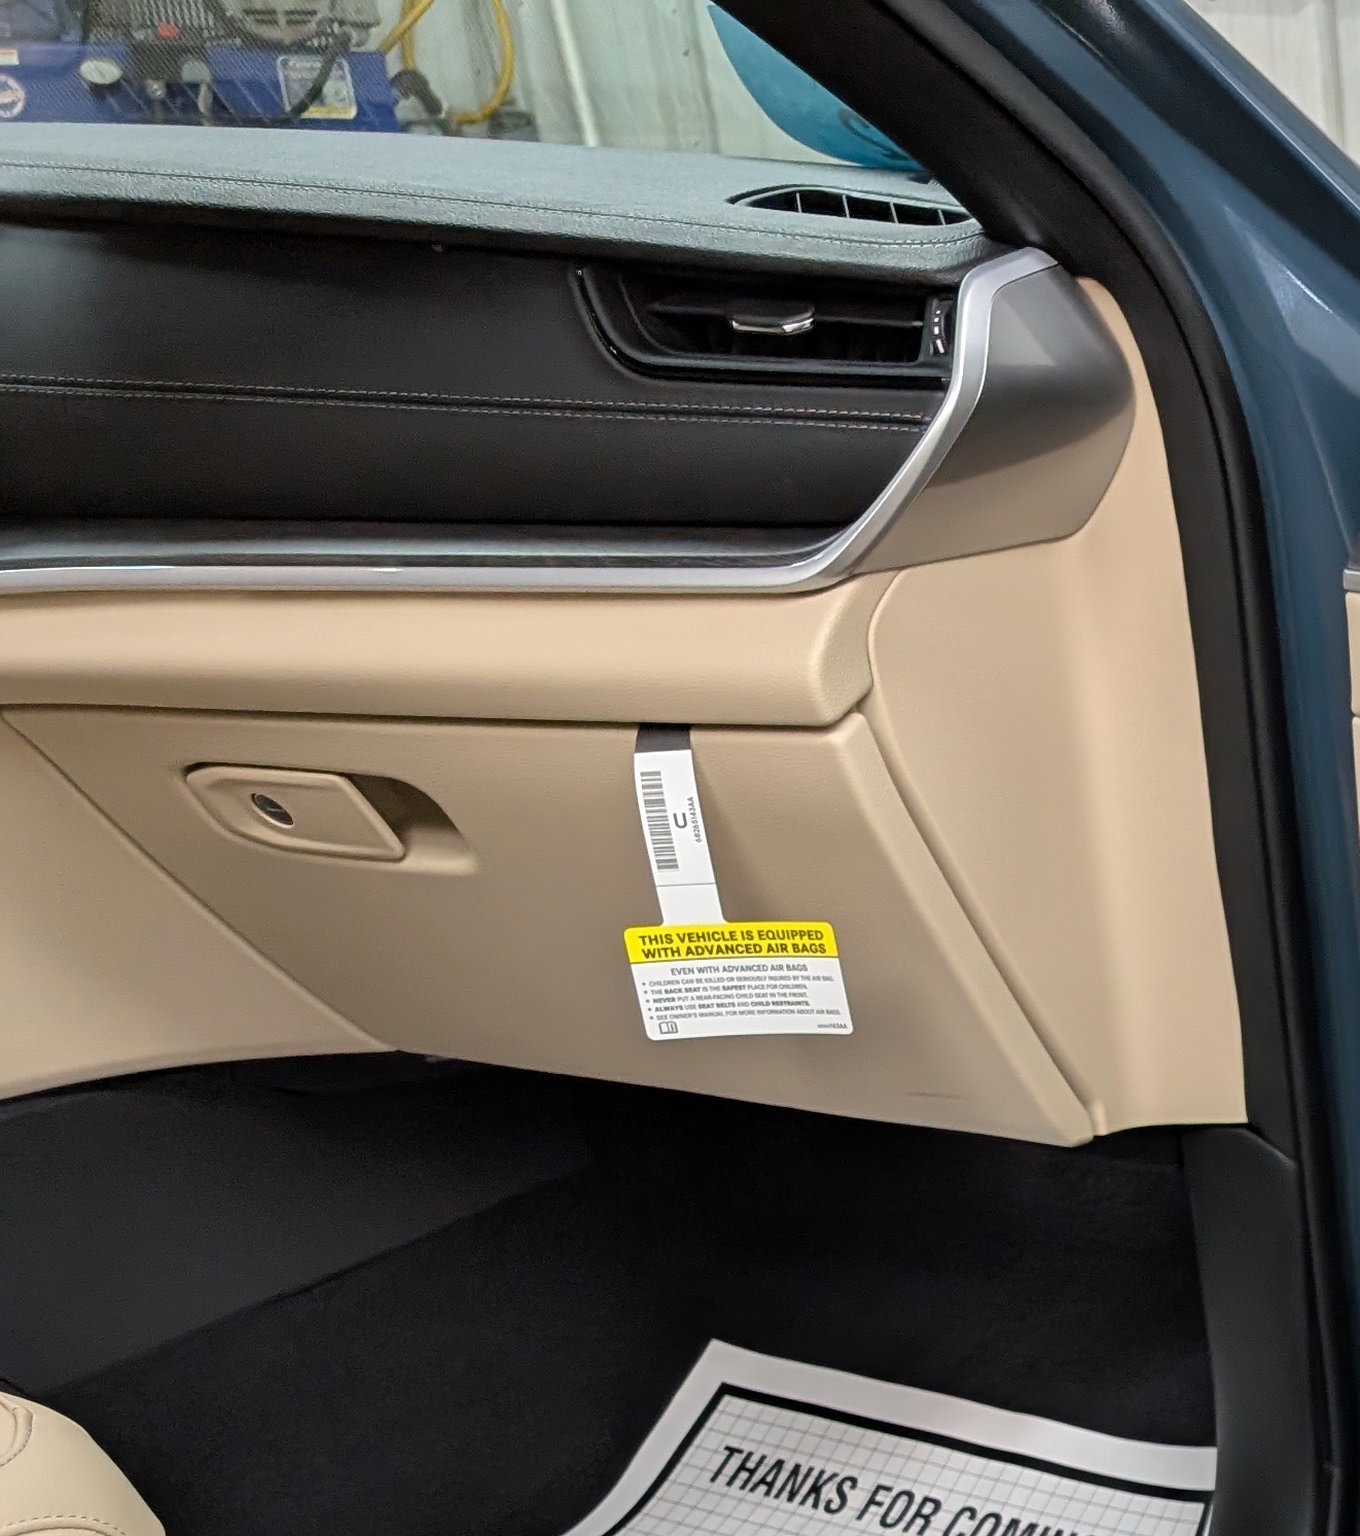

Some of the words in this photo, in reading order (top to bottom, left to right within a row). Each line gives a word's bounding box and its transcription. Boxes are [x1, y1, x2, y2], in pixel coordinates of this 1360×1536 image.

[673, 812, 688, 829] U
[639, 934, 674, 946] THIS
[676, 931, 738, 943] VEHICLE
[742, 931, 754, 941] IS
[758, 930, 824, 942] EQUIPPED
[642, 948, 682, 960] WITH
[685, 944, 762, 957] ADVANCED
[767, 944, 789, 954] AIR
[793, 943, 827, 954] BAGS
[670, 967, 695, 976] EVEN
[696, 966, 720, 974] WITH
[722, 964, 769, 974] ADVANCED
[770, 964, 785, 972] AIR
[786, 964, 809, 972] BAGS
[655, 1004, 684, 1012] ALWAYS
[698, 1002, 715, 1010] SEAT
[710, 1445, 858, 1514] THANKS
[855, 1483, 942, 1536] FOR
